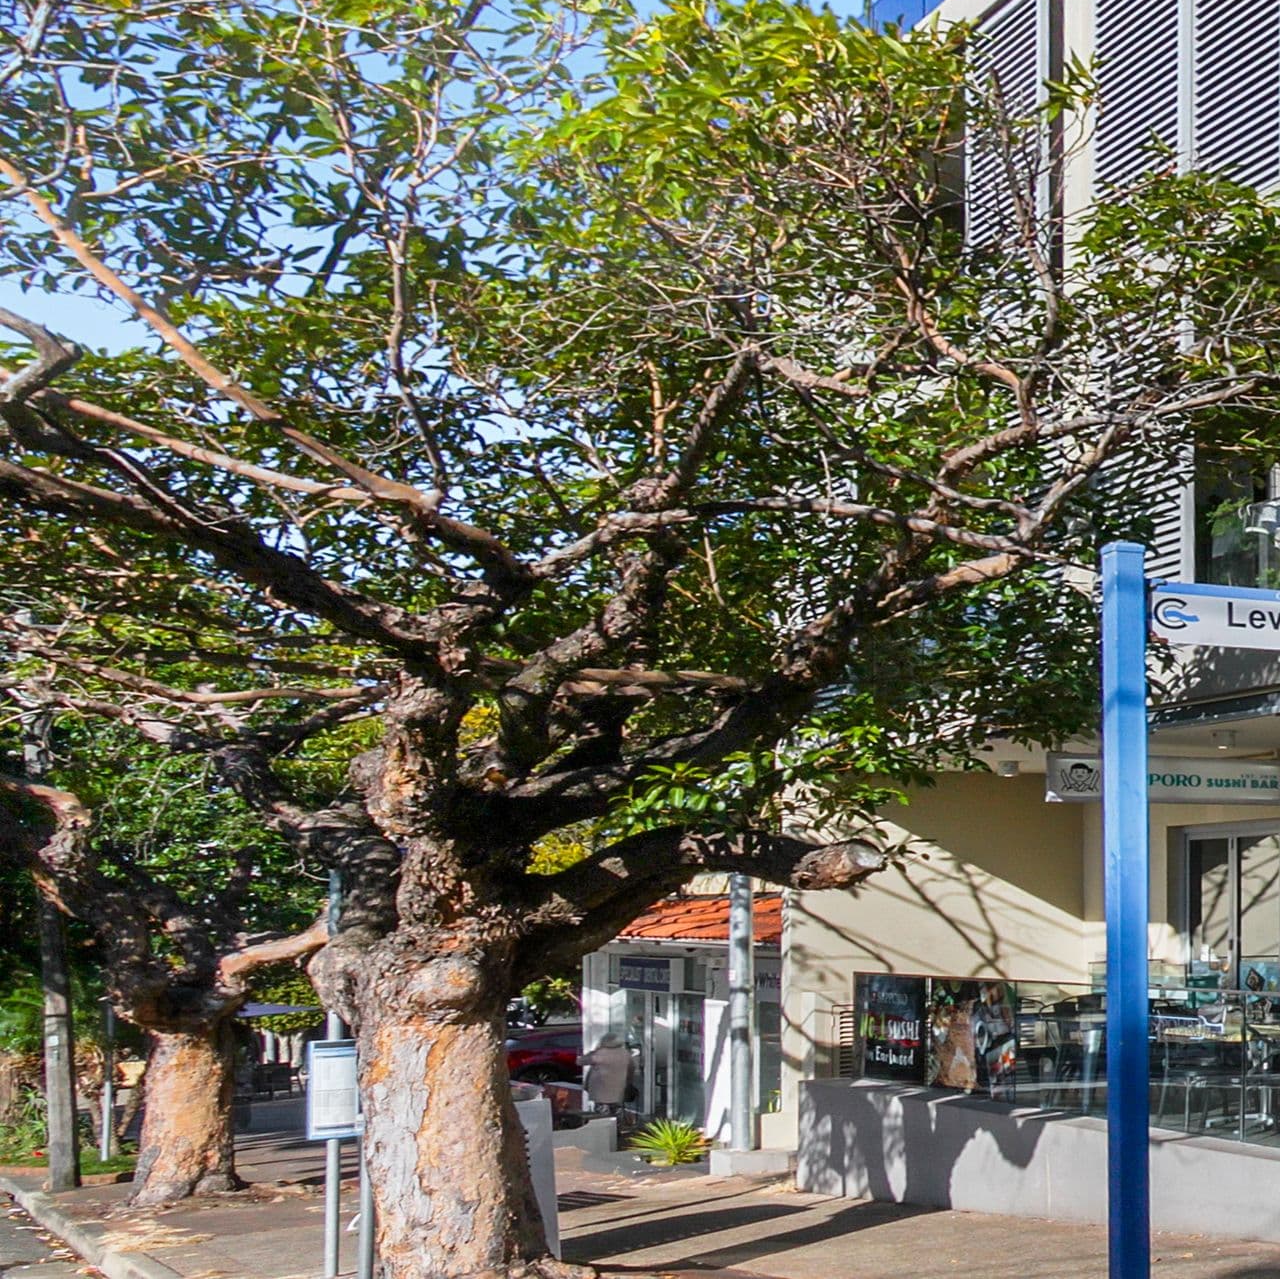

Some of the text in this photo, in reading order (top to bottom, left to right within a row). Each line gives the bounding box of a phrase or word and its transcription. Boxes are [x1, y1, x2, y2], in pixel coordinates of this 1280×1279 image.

[1146, 773, 1202, 788] PORO
[1250, 779, 1280, 789] BAR
[887, 1020, 921, 1041] SUSHI
